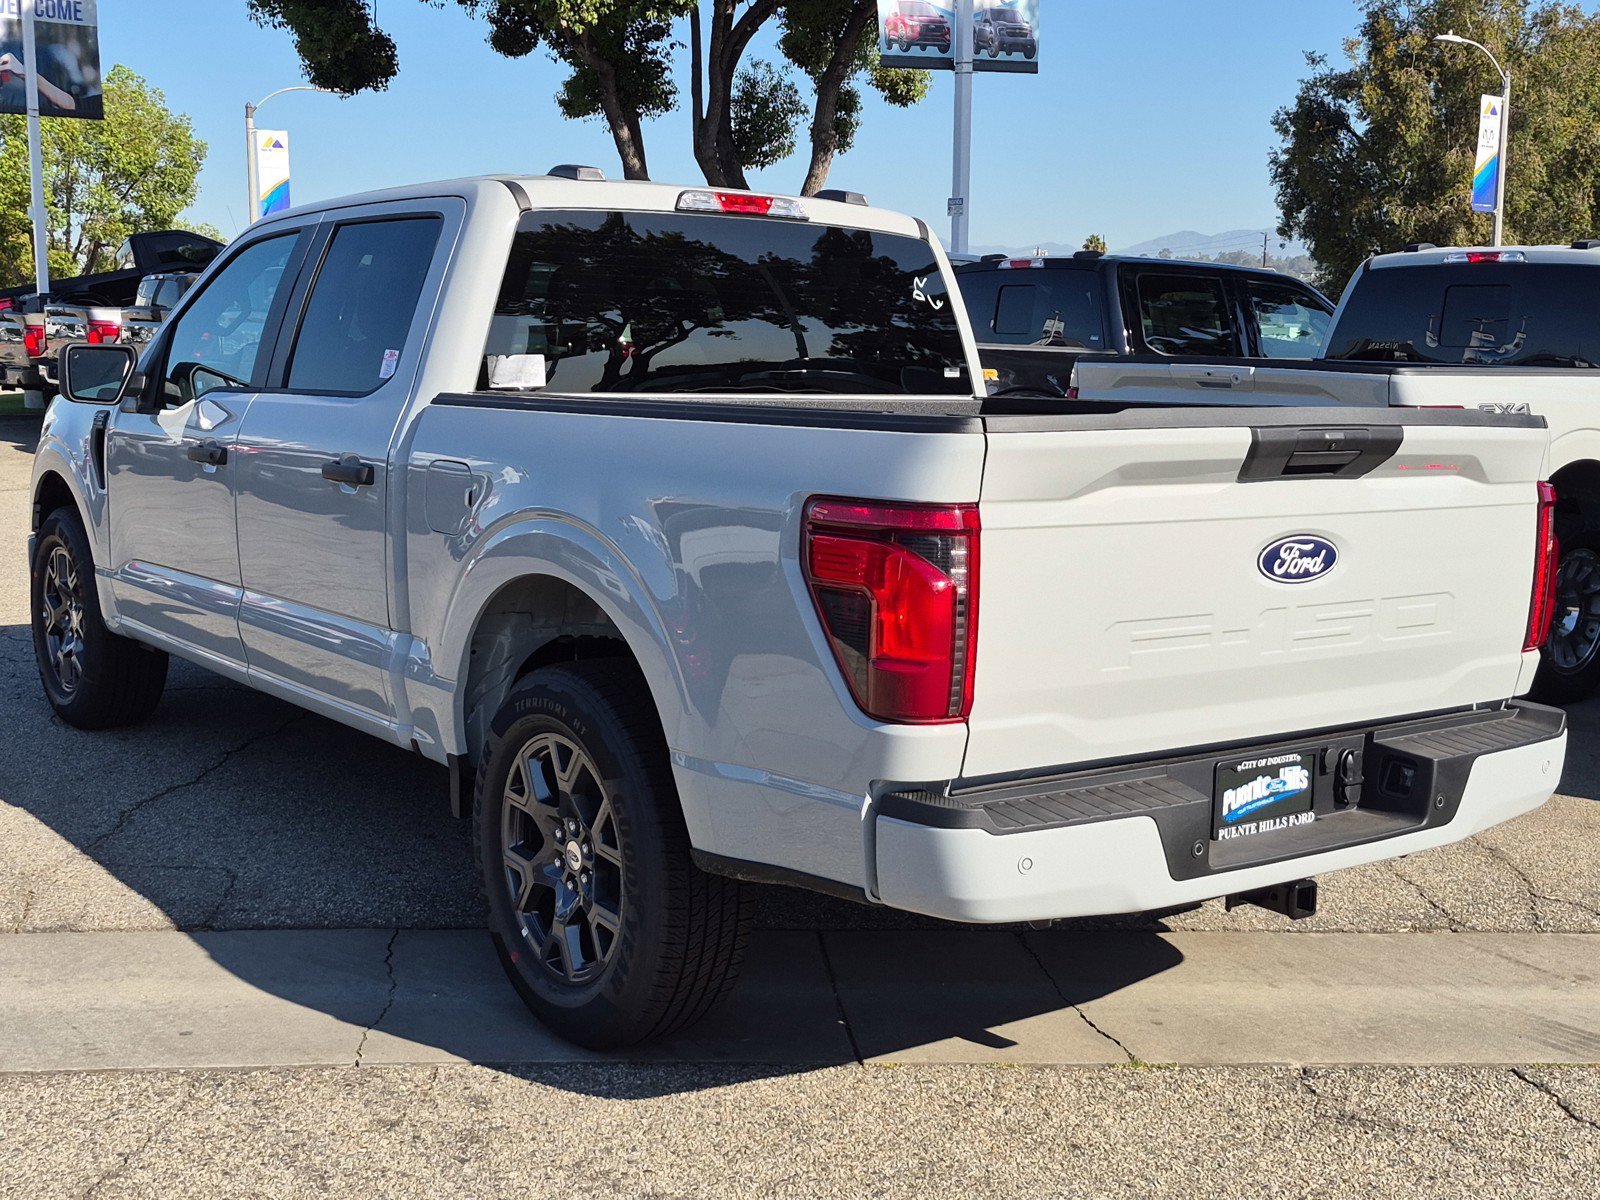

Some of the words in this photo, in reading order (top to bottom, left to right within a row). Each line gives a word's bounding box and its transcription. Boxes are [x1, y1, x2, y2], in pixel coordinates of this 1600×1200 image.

[1478, 402, 1531, 415] FX4
[1273, 542, 1326, 575] Ford
[1100, 591, 1454, 672] F-150
[515, 697, 568, 717] TERRITORY
[573, 718, 588, 735] HT
[1241, 760, 1258, 769] CITY
[1258, 758, 1268, 767] OF
[1267, 753, 1298, 766] INDUSTRY
[1218, 822, 1257, 840] PUENTE
[1259, 816, 1288, 833] HILLS
[1288, 811, 1315, 827] FORD
